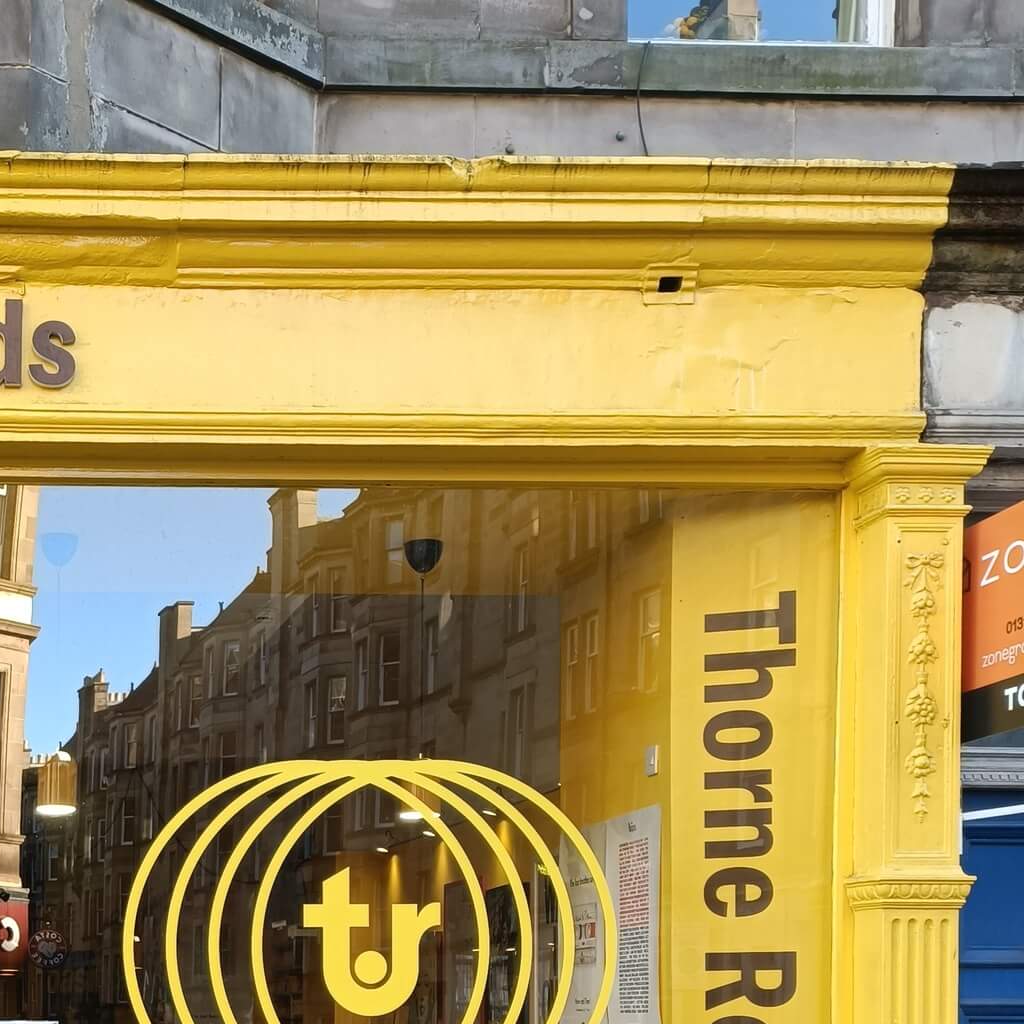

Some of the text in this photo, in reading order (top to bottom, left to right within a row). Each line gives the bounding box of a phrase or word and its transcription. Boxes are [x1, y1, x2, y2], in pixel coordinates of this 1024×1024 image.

[1006, 616, 1024, 634] 013
[703, 590, 797, 917] Thorne
[303, 866, 441, 1017] tr
